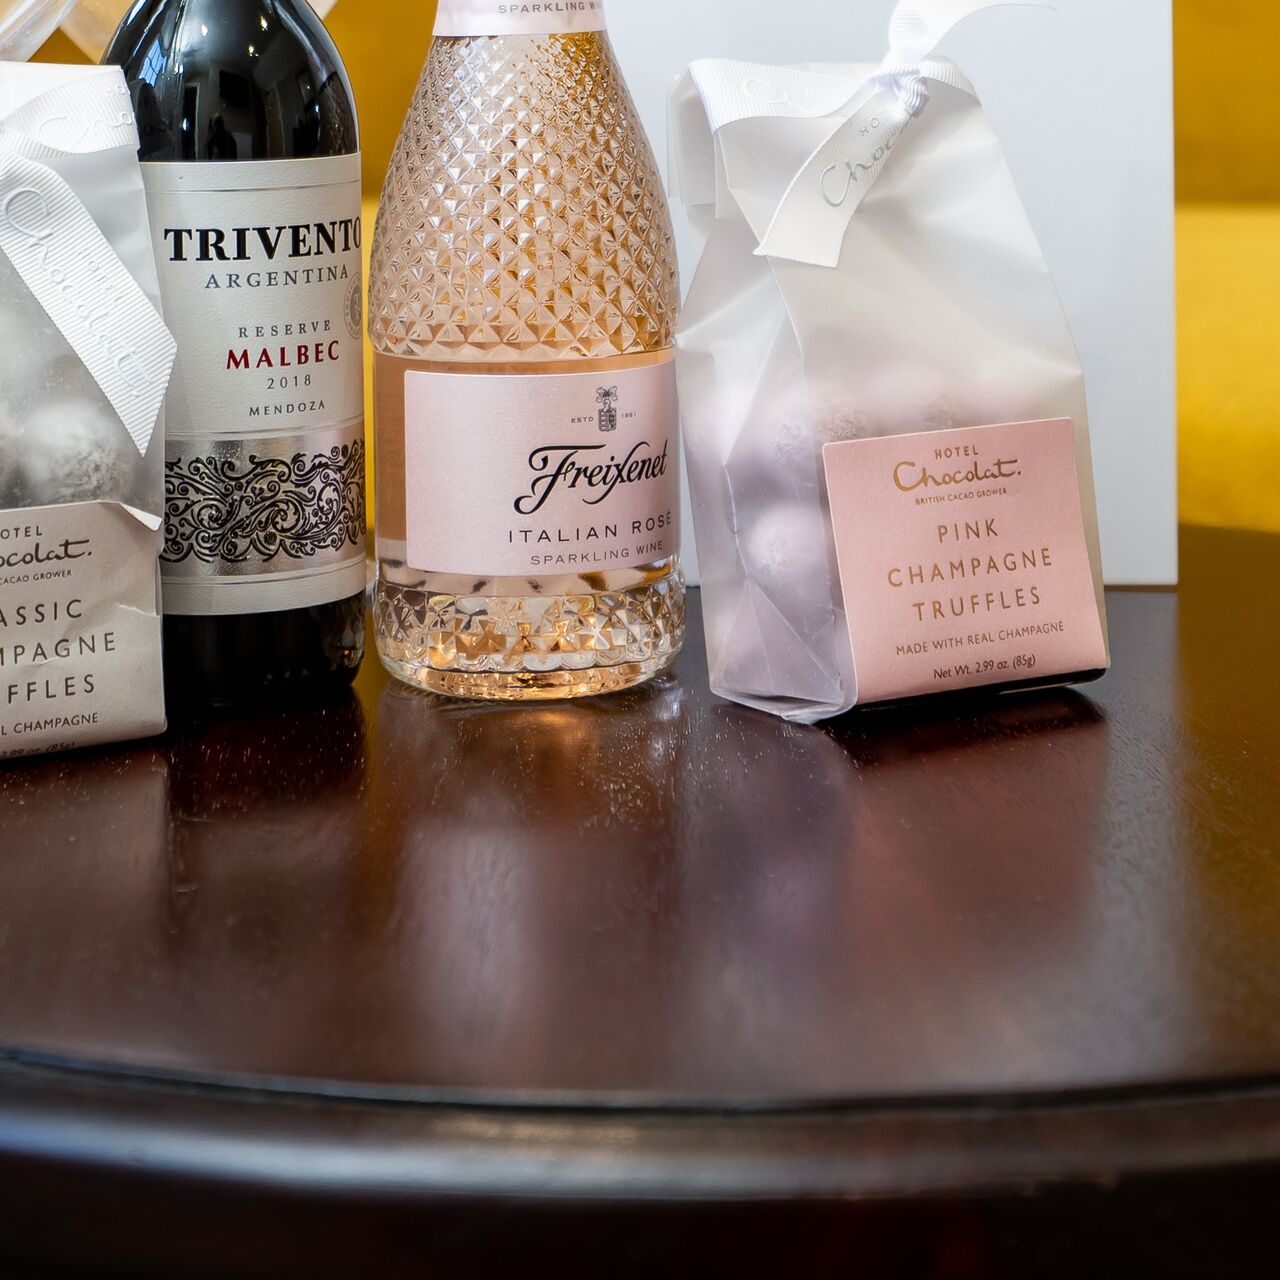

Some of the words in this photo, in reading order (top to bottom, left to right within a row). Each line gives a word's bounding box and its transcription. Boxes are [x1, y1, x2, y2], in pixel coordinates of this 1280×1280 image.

[498, 2, 586, 14] SPARKLING
[163, 216, 361, 261] TRIVENTO
[204, 263, 349, 288] ARGENTINA
[238, 320, 331, 338] RESERVE
[226, 340, 339, 370] MALBEC
[267, 374, 312, 389] 2018
[249, 399, 325, 416] MENDOZA
[934, 444, 979, 460] HOTEL
[513, 439, 668, 515] Freixenet
[893, 458, 1022, 492] Chocolat.
[915, 494, 945, 505] BRITISH
[947, 491, 975, 503] CACAO
[976, 487, 1008, 499] GROWER
[509, 524, 618, 544] ITALIAN
[937, 518, 999, 544] PINK
[531, 548, 629, 566] SPARKLING
[636, 540, 663, 555] WINE
[33, 569, 72, 581] GROWER
[887, 548, 1053, 589] CHAMPAGNE
[912, 585, 1041, 622] TRUFFLES
[896, 641, 928, 656] MADE
[931, 637, 963, 651] WITH
[967, 632, 995, 646] REAL
[998, 620, 1065, 641] CHAMPAGNE
[933, 667, 952, 680] Net
[954, 664, 972, 677] Wt.
[975, 660, 995, 673] 2.99
[997, 660, 1010, 670] oz
[1012, 653, 1036, 670] (85g)
[13, 712, 99, 734] CHAMPAGNE
